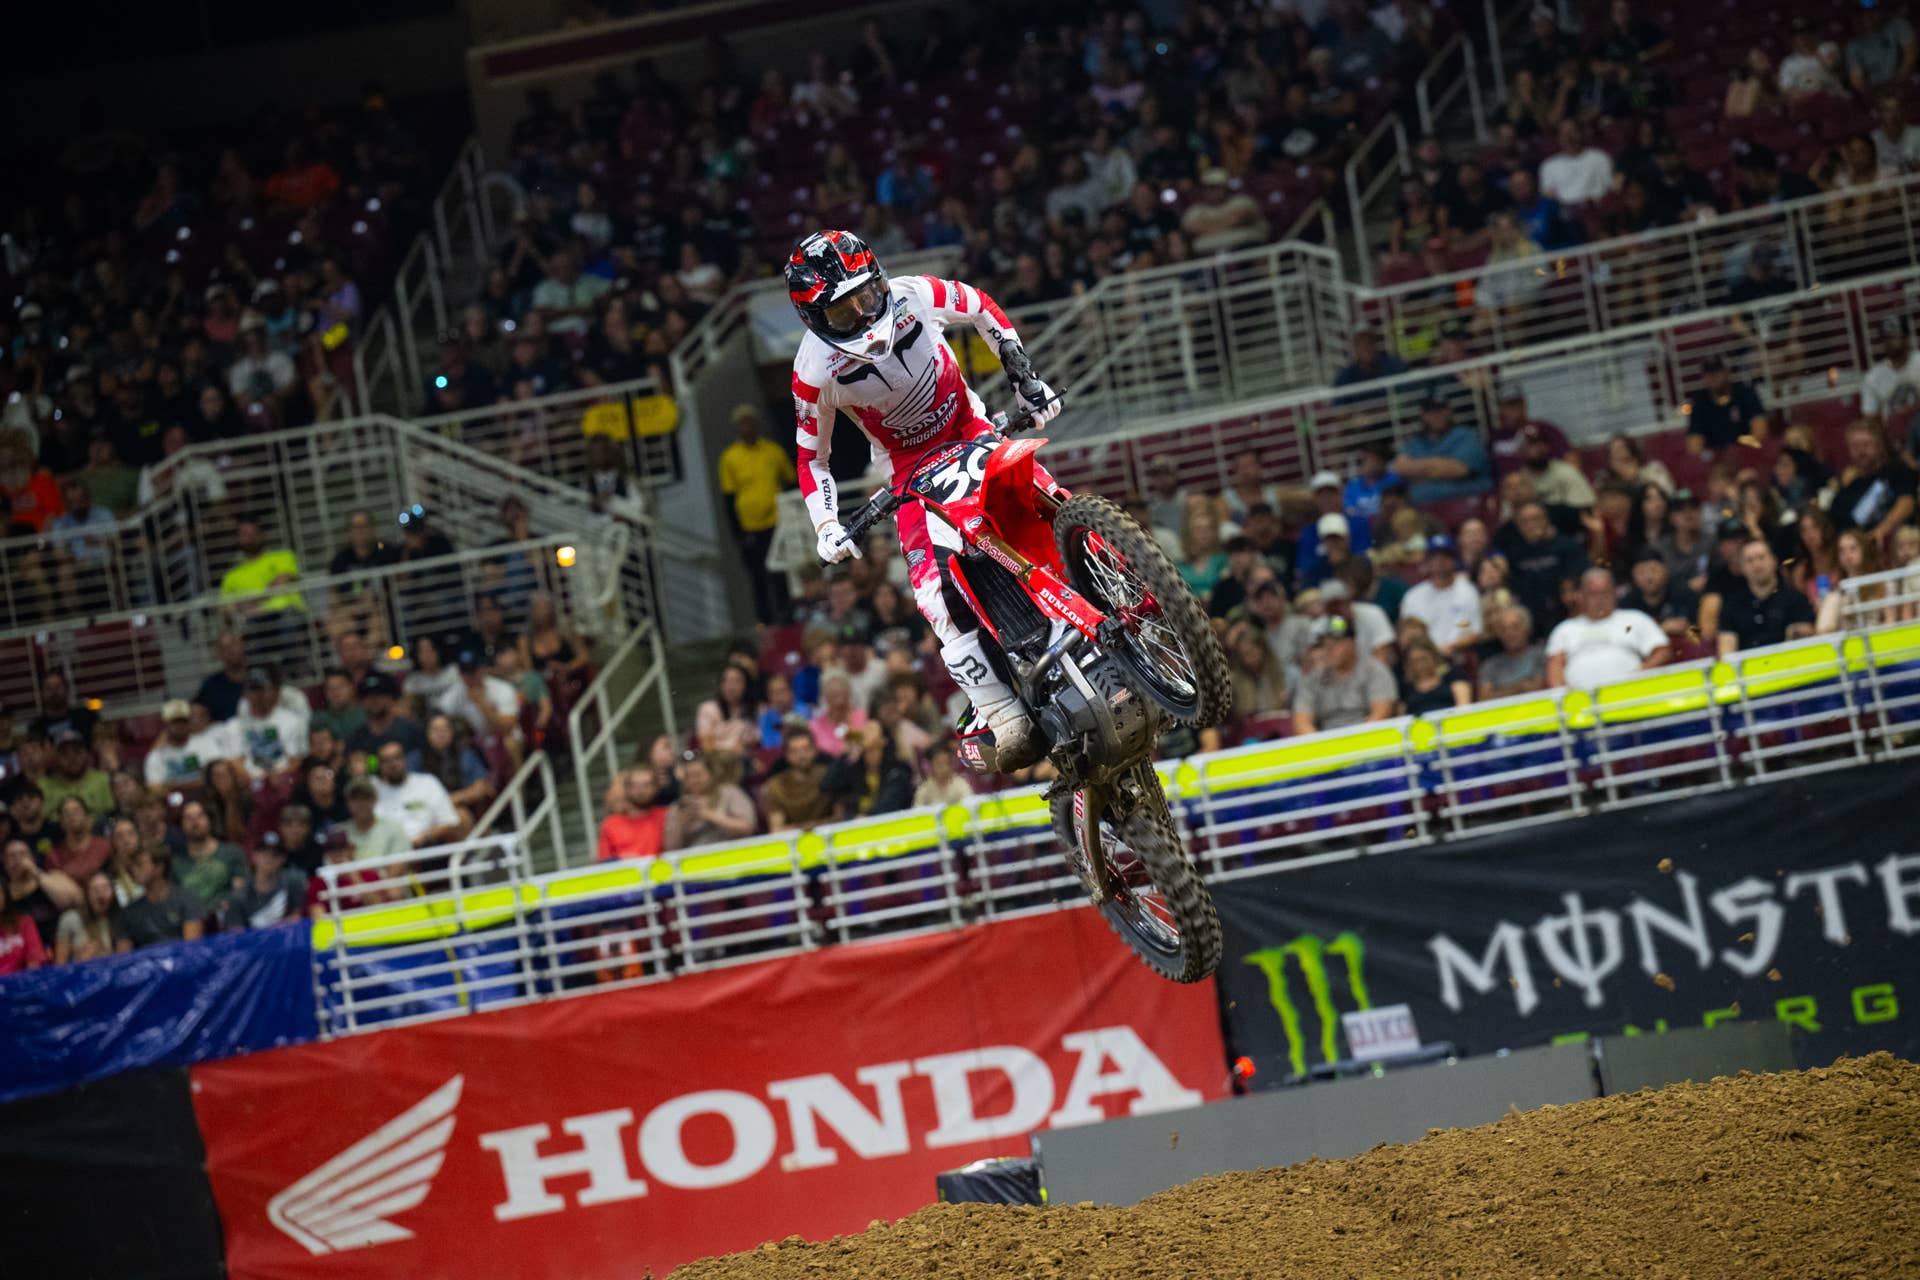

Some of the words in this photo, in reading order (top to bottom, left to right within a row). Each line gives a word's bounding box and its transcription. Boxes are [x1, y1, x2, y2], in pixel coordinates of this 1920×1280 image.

[891, 392, 957, 439] HONDA
[989, 545, 1022, 576] SHOWA
[1040, 588, 1084, 626] DUNLOP
[480, 1025, 1202, 1222] HONDA
